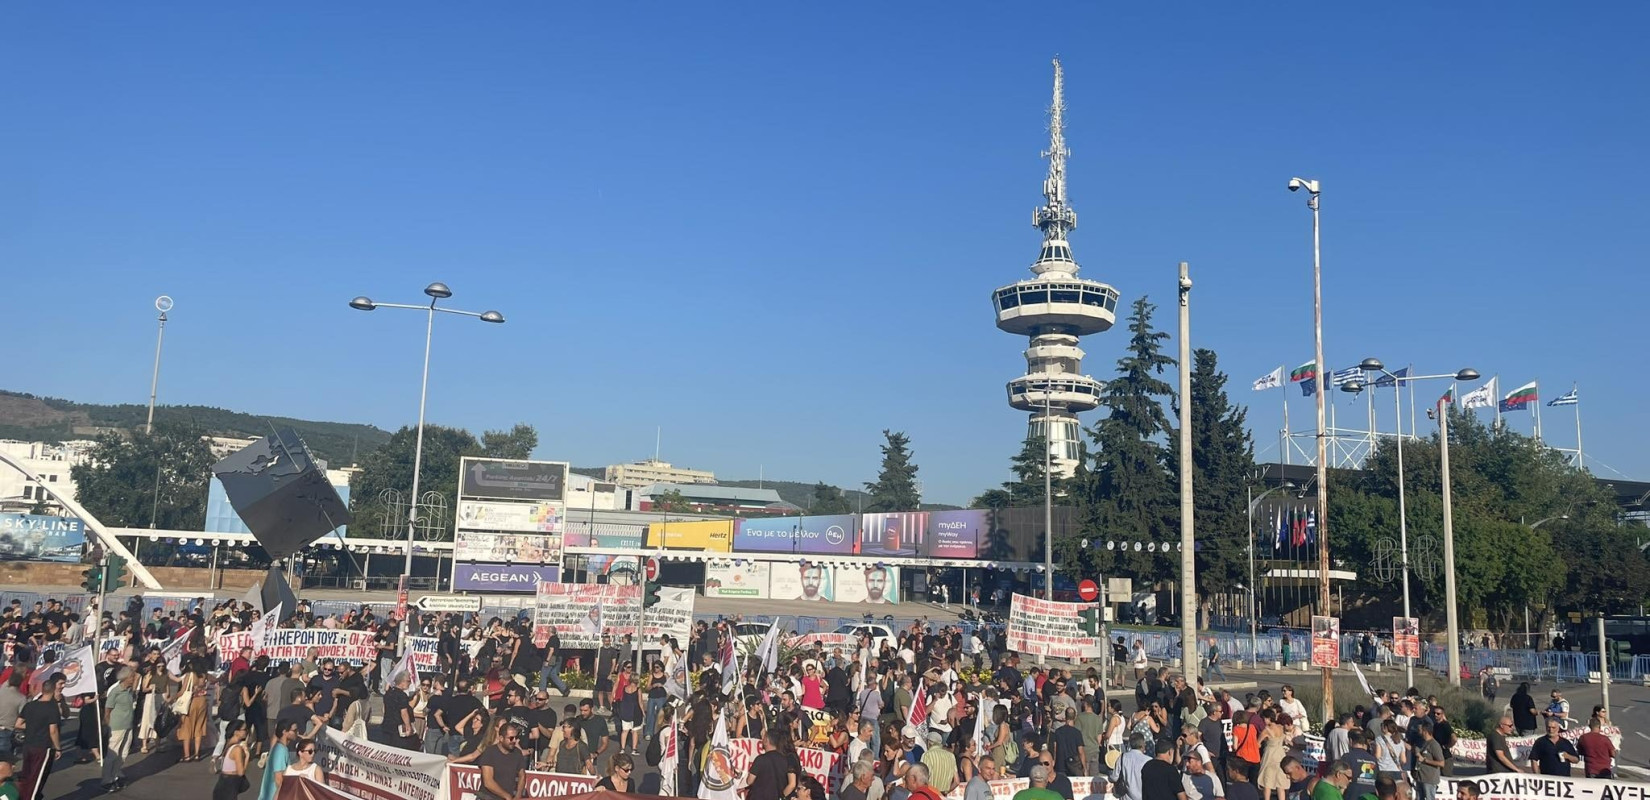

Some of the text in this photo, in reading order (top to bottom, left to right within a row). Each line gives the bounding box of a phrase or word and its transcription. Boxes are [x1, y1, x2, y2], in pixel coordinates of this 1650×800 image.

[746, 528, 762, 537] Ένα
[764, 530, 775, 539] με
[789, 530, 819, 539] μέλλον
[827, 530, 842, 539] ΔΕΗ
[470, 572, 529, 582] AEGEAN
[278, 631, 315, 646] ΚΕΡΔΗ
[317, 632, 339, 645] ΤΟΥΣ
[349, 632, 360, 646] ΟΙ
[276, 646, 292, 657] ΓΙΑ
[294, 646, 307, 657] ΤΙΣ
[530, 778, 568, 798] ΟΛΩΝ
[1448, 779, 1575, 798] ΠΟΣΛΗΨΕΙΣ
